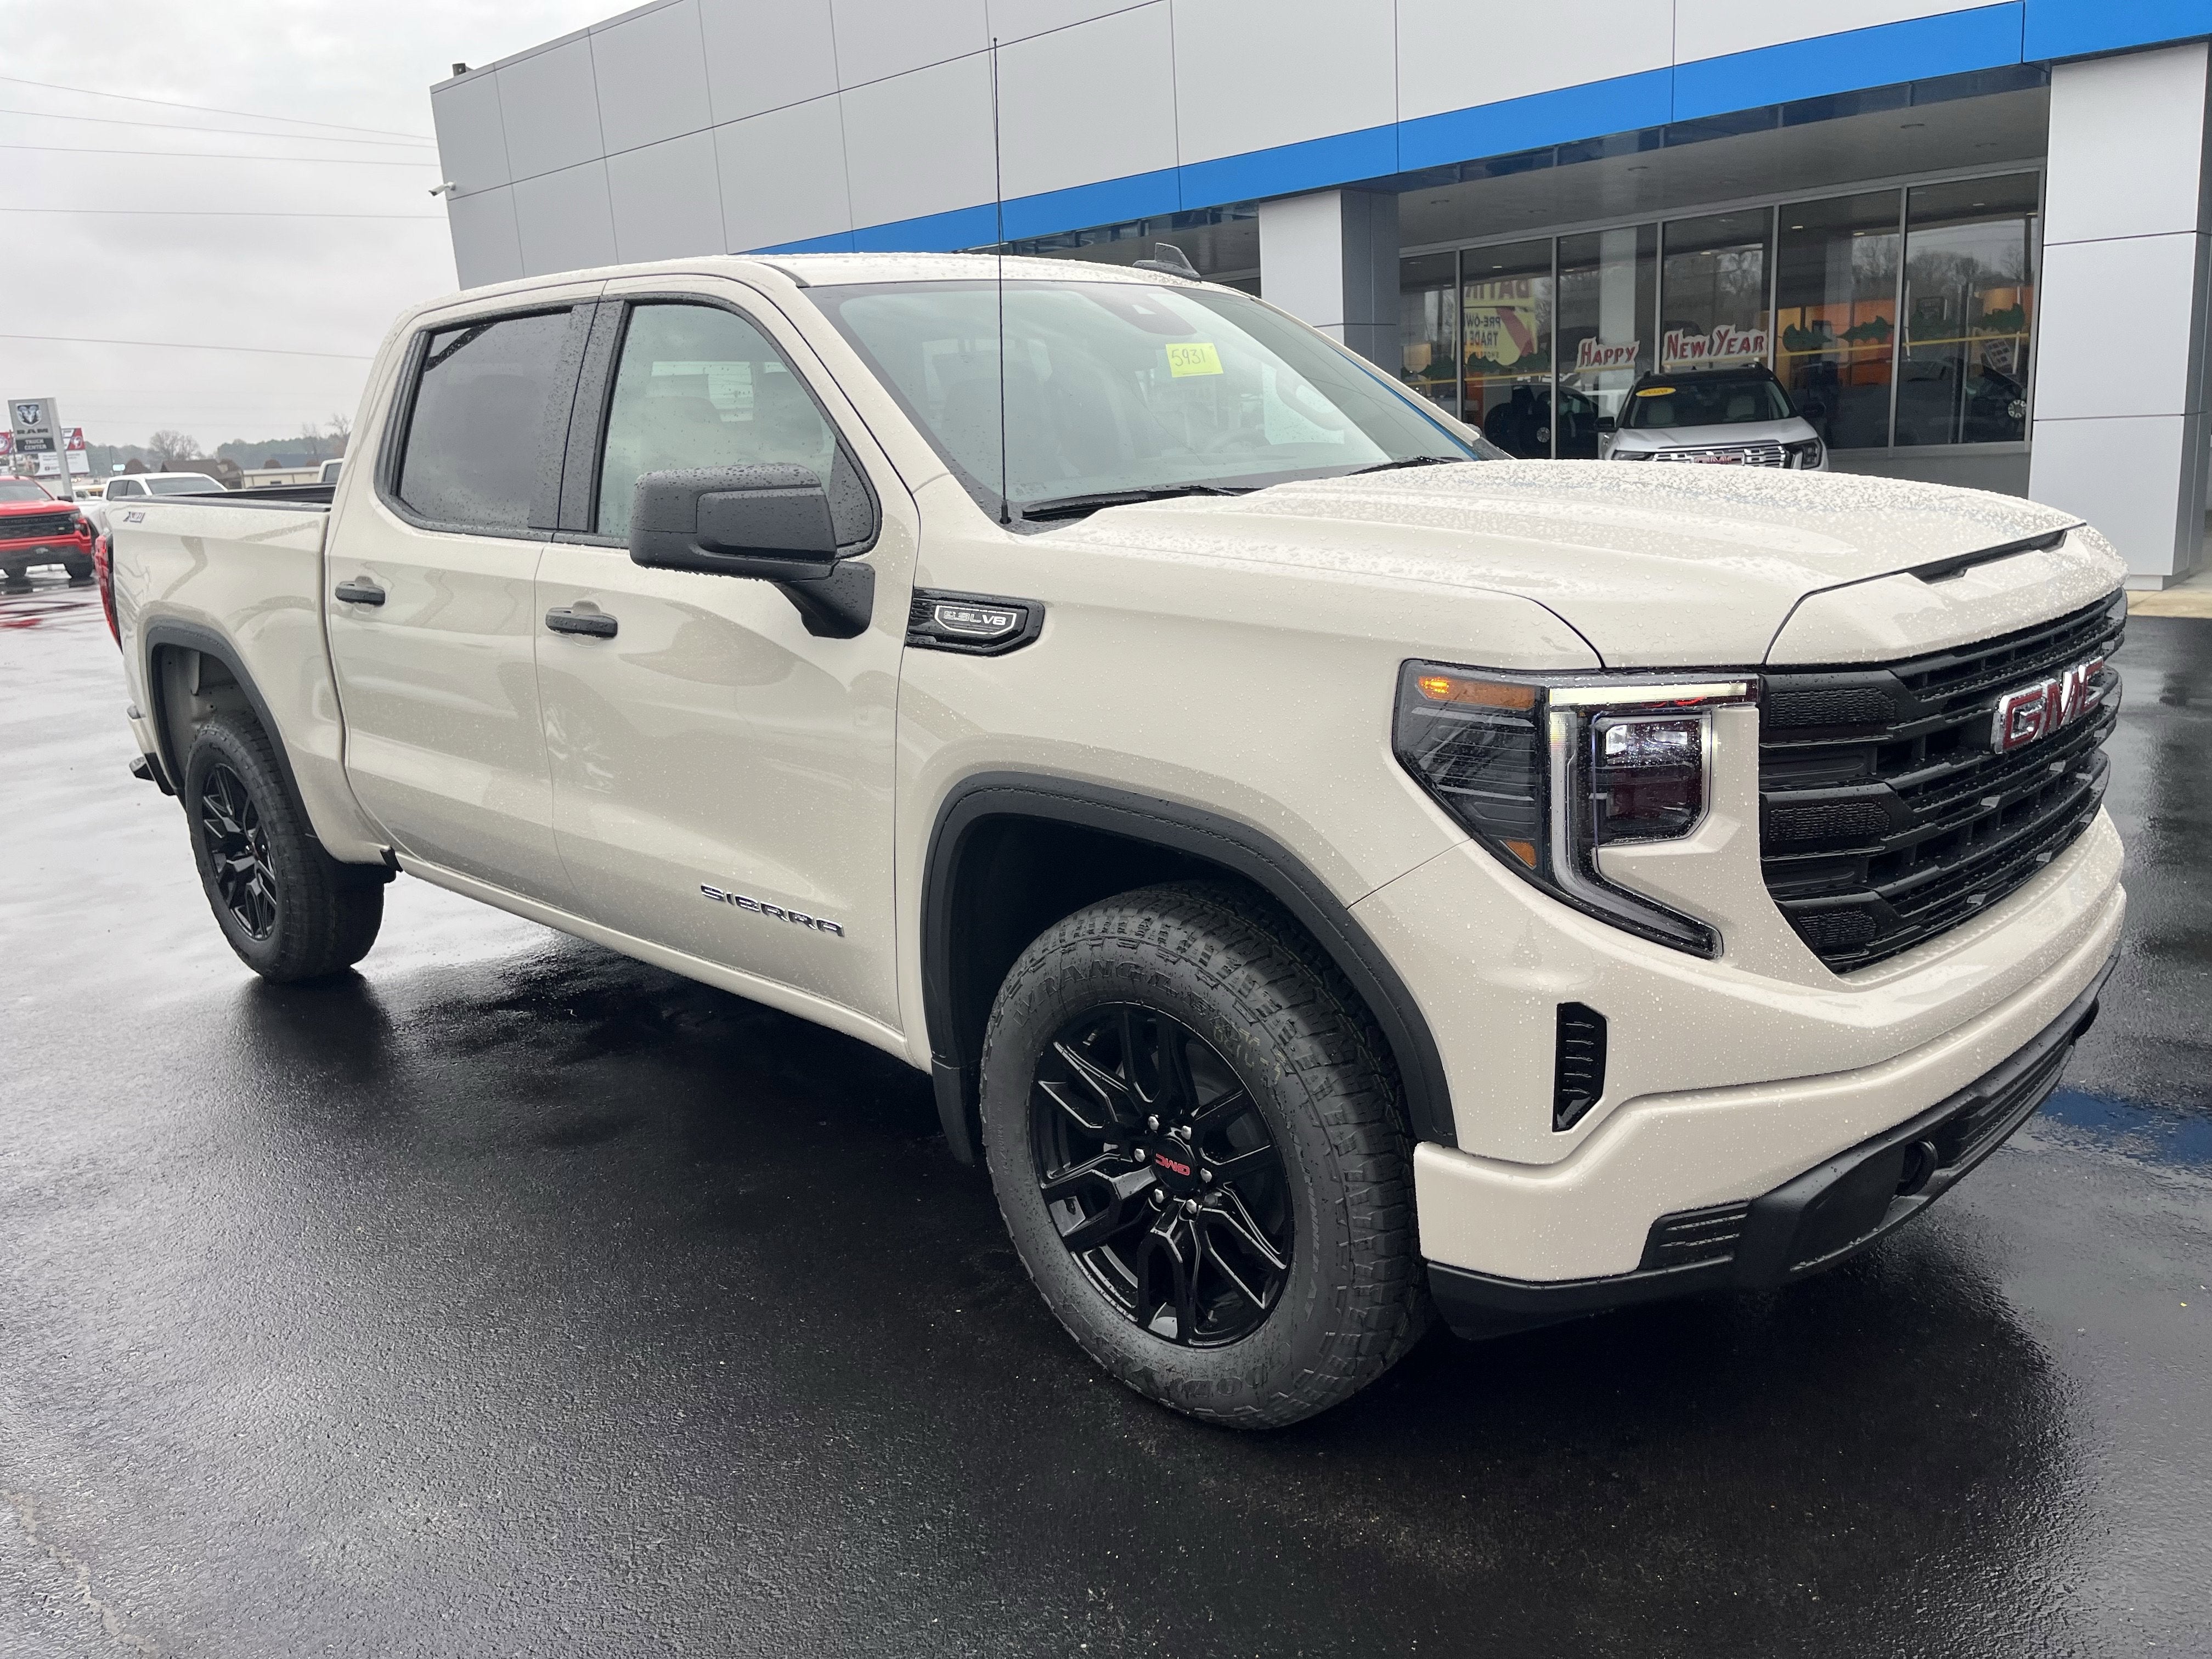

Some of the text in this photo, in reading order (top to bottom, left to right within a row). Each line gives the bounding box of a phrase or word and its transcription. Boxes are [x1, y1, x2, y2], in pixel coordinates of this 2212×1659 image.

[1171, 348, 1205, 366] 5931
[1990, 656, 2104, 754] GMC
[701, 882, 845, 938] SIERRA
[1155, 1153, 1190, 1176] GMC
